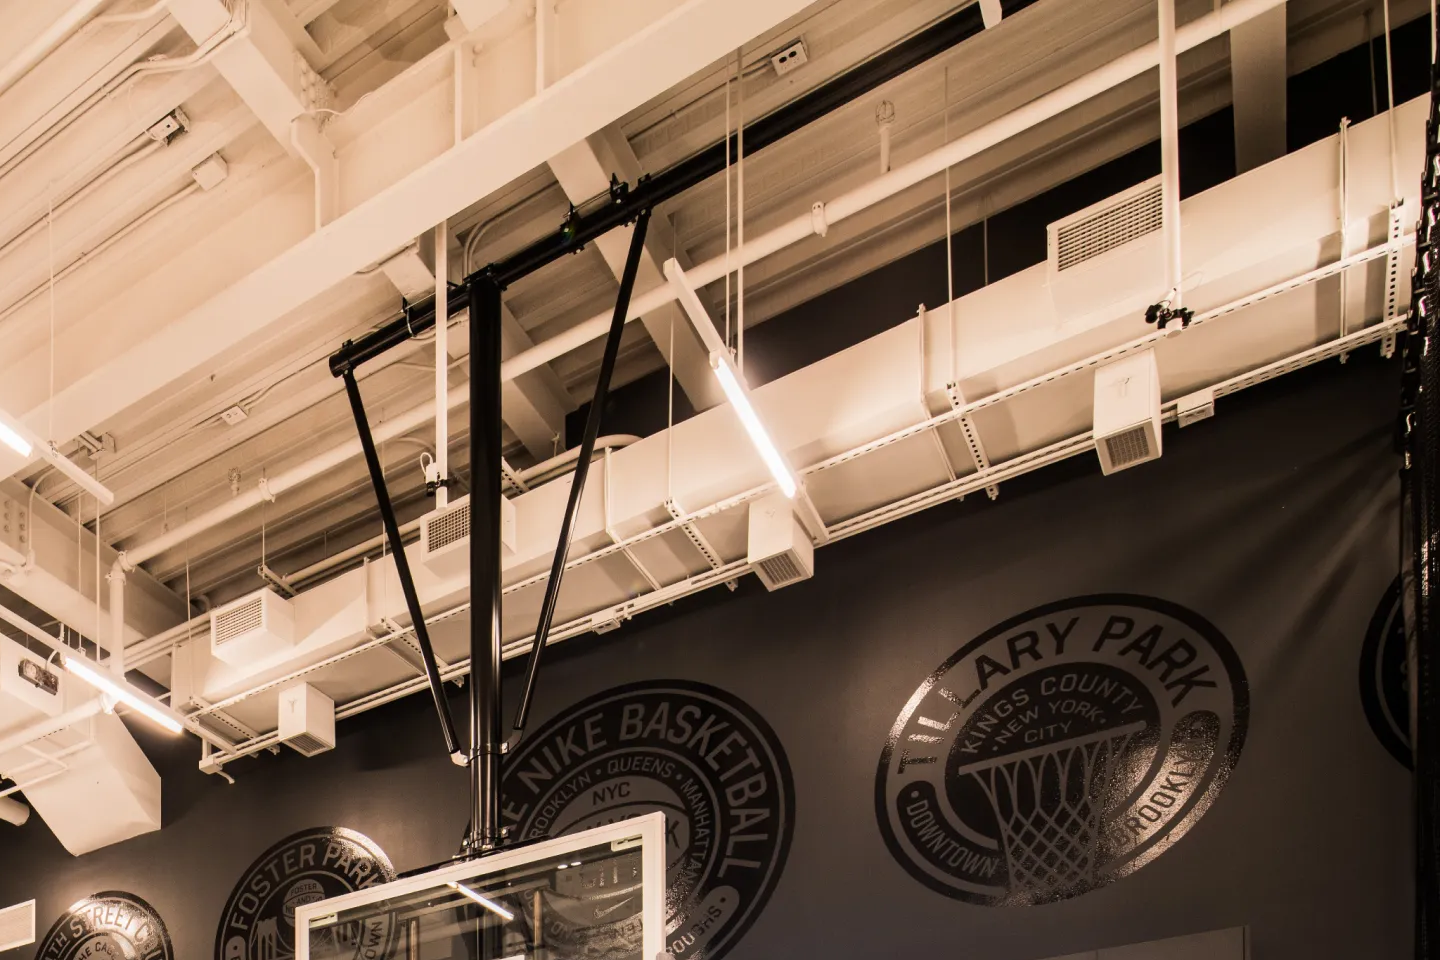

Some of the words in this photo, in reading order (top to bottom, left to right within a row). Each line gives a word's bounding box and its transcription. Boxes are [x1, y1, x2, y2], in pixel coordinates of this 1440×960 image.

[897, 617, 1080, 776] TILLARY
[1092, 614, 1219, 708] PARK
[962, 688, 1030, 755] KINGS
[1040, 673, 1146, 716] COUNTY
[997, 705, 1041, 747] NEW
[1049, 698, 1100, 726] YORK
[1024, 720, 1074, 745] CITY
[517, 713, 608, 795] NIKE
[618, 701, 772, 879] BASKETBALL
[530, 771, 592, 838] ROOKLYN
[607, 756, 676, 777] QUEENS
[680, 778, 714, 888] MANHATTAN
[593, 781, 632, 806] NYC
[906, 799, 1000, 879] DOWNTOWN
[231, 844, 316, 930] FOSTER
[290, 882, 317, 897] FOSTER
[70, 905, 137, 938] STREET
[364, 921, 384, 960] OWN
